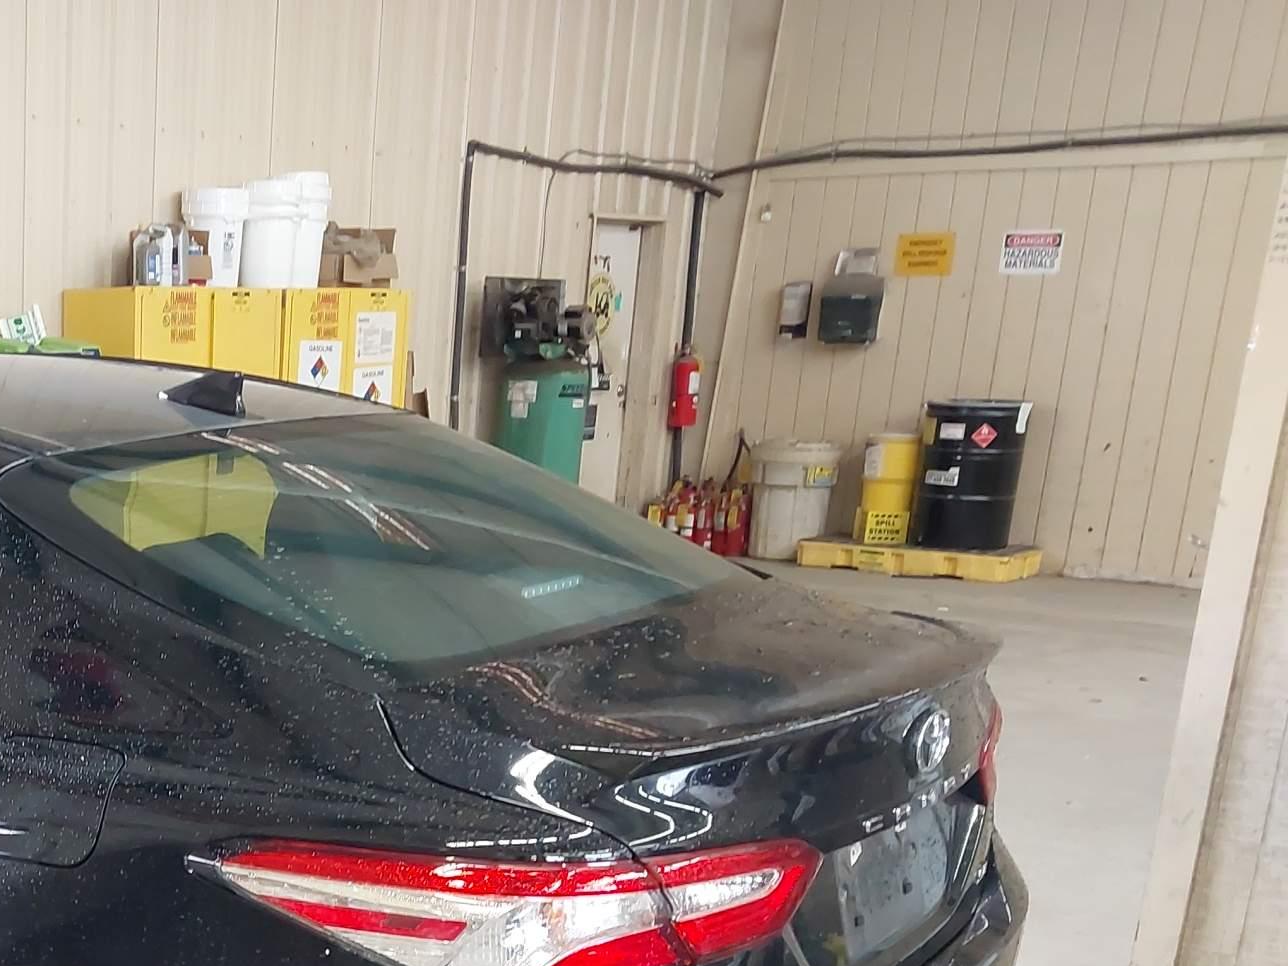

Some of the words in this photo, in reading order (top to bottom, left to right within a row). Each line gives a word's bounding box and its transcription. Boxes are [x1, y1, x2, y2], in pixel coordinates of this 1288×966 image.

[1012, 235, 1054, 246] DANGER
[1004, 247, 1059, 258] HAZARDOUS
[1004, 258, 1055, 269] MATERIALS
[308, 344, 334, 352] GASOLINE
[875, 519, 895, 527] SPILL
